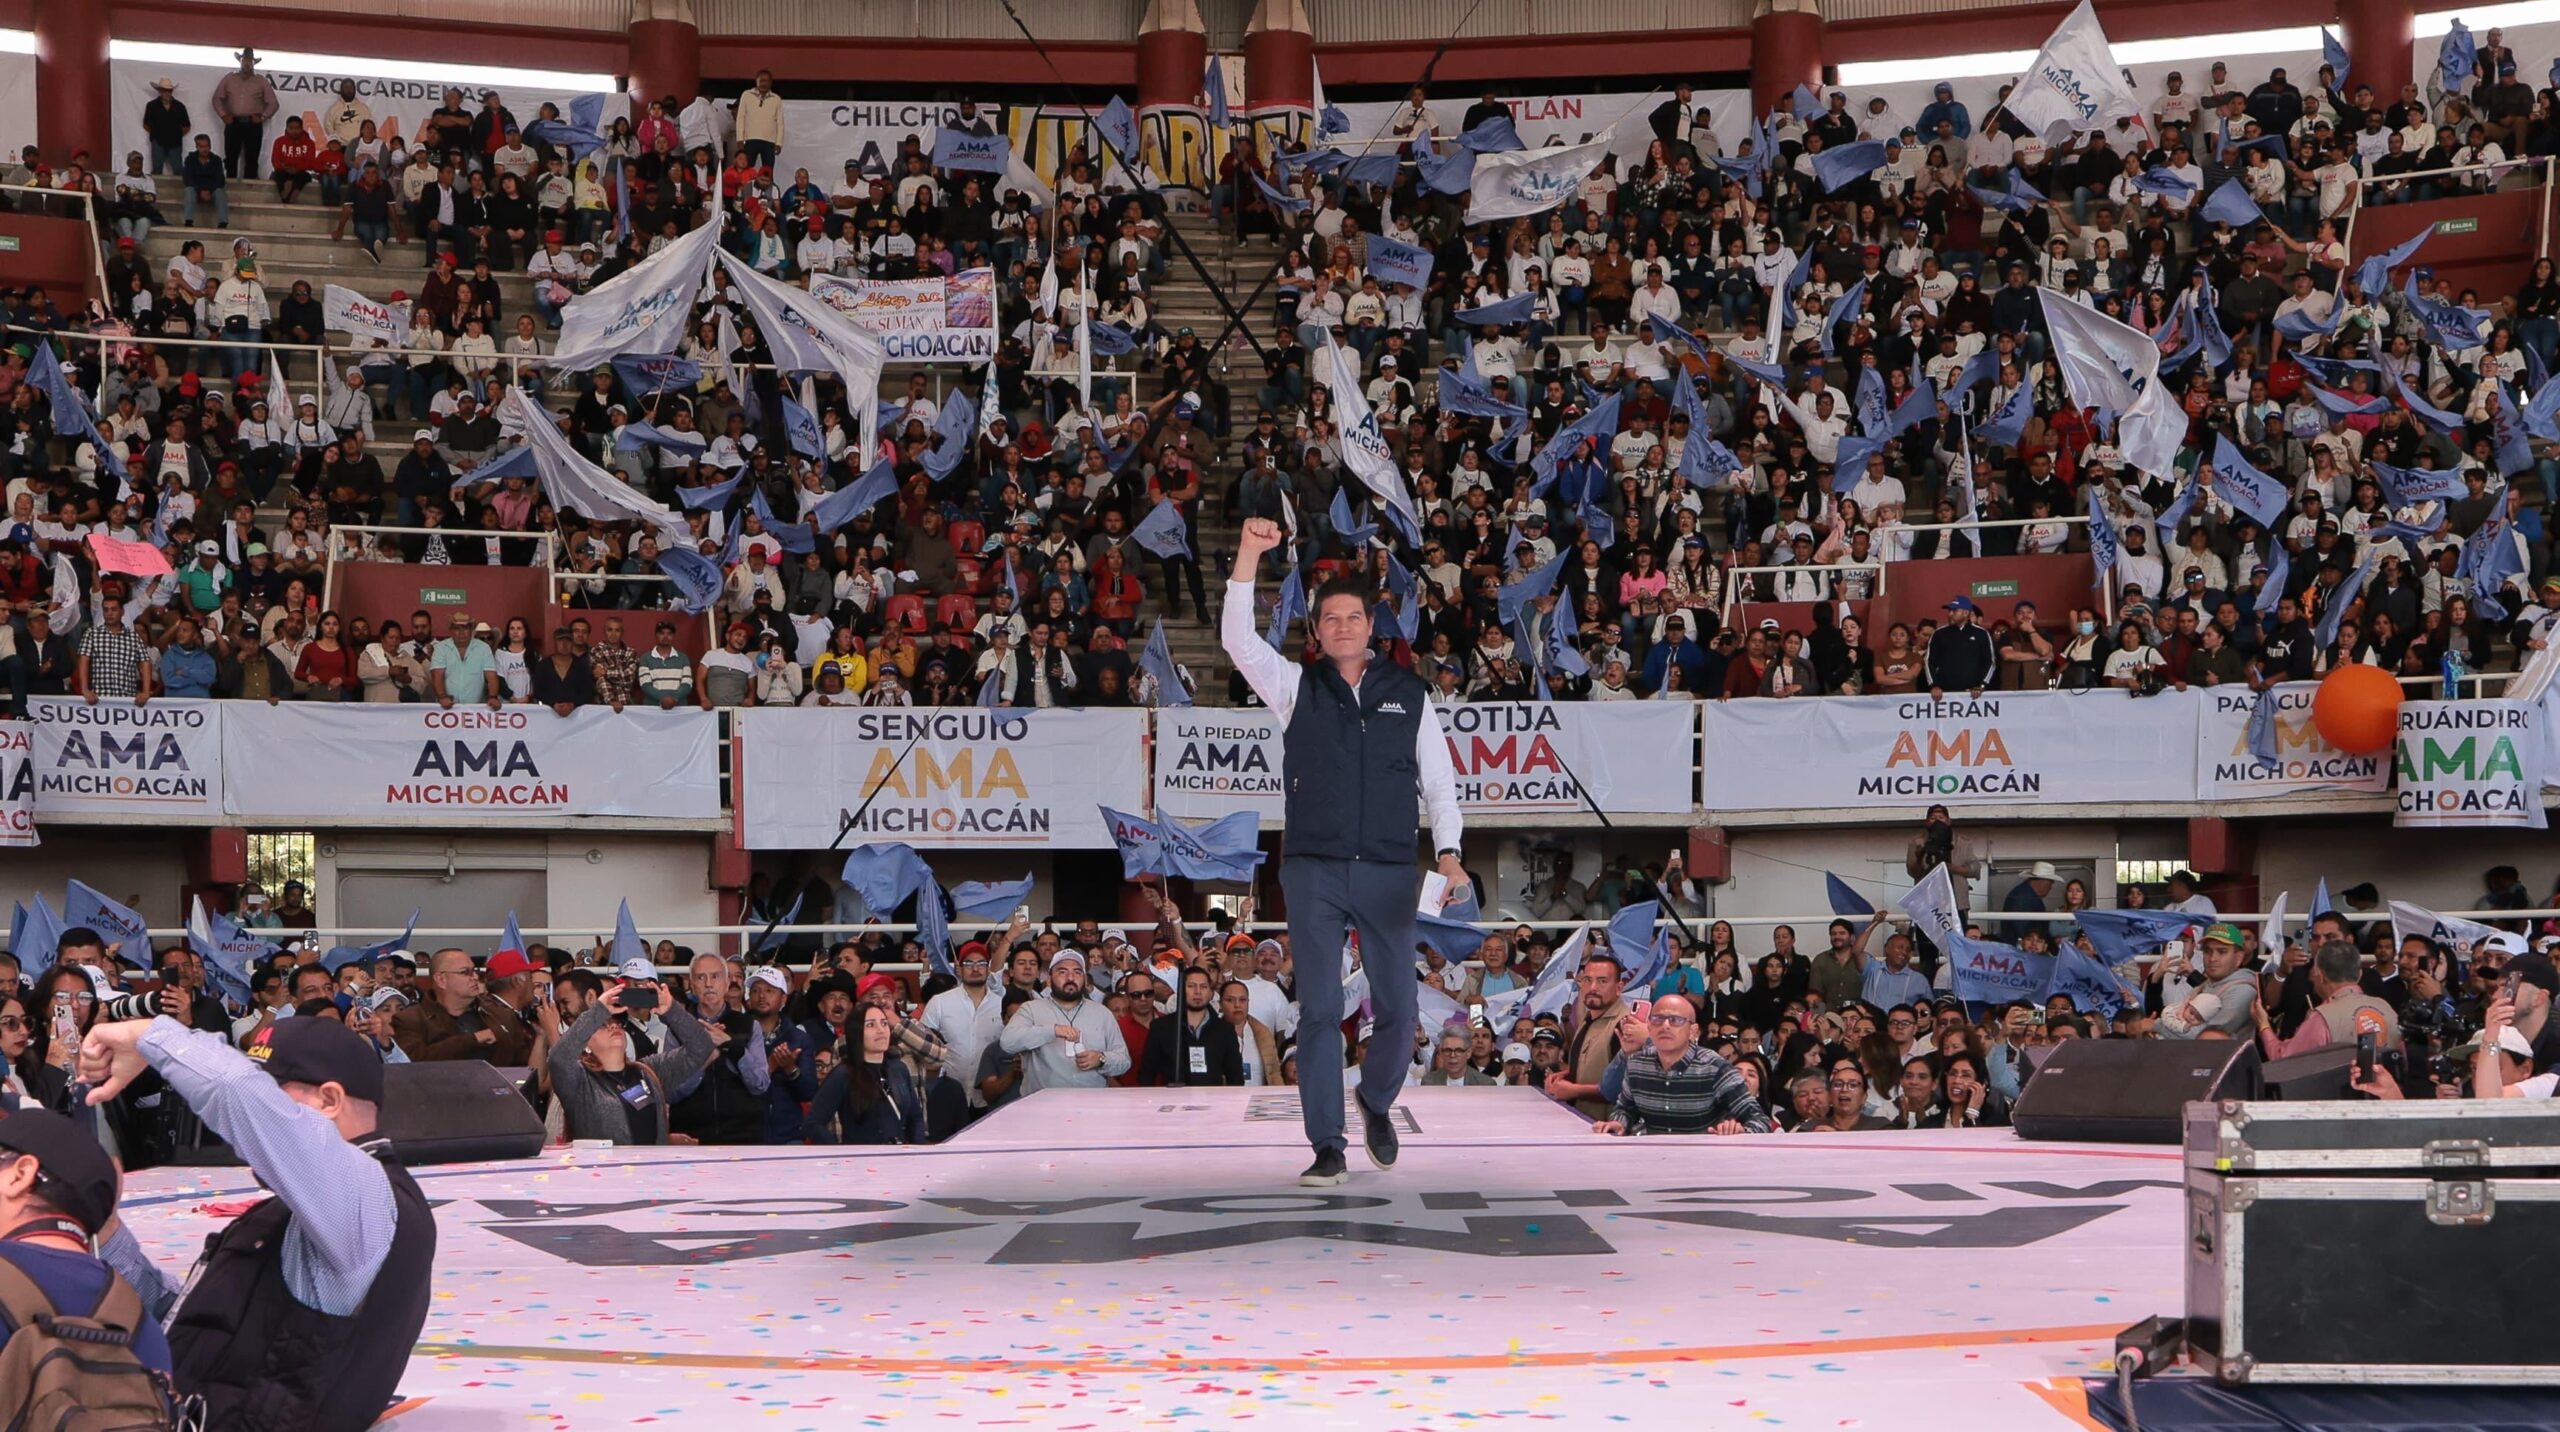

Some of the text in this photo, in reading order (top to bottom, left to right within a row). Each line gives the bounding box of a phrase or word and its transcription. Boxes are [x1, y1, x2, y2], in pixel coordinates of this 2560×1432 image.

[267, 71, 342, 94] ÁZARO
[2060, 67, 2100, 122] AMA
[832, 105, 959, 127] CHILCHO
[1508, 96, 1582, 120] TLÁN
[956, 141, 990, 152] AMA
[1379, 247, 1415, 265] AMA
[350, 301, 389, 321] AMA
[2424, 311, 2466, 327] AMA
[163, 453, 185, 461] AMA
[2222, 464, 2260, 496] AMA
[690, 562, 717, 595] AM
[1847, 571, 1867, 579] AMA
[2119, 661, 2136, 669] AM
[40, 704, 205, 728] SUSUPUATO
[424, 711, 528, 730] COENEO
[857, 714, 1028, 742] SENGUIO
[1434, 705, 1562, 733] COTIJA
[1177, 725, 1272, 741] LA PIEDAD
[56, 729, 191, 771] AMA
[412, 739, 541, 778] AMA
[1176, 742, 1271, 774] AMA
[1446, 734, 1562, 776] AMA
[1886, 729, 2013, 768] AMA
[2398, 736, 2524, 783] AMA
[858, 747, 1029, 799] AMA
[2215, 753, 2377, 782] MICHOACÁN
[41, 773, 207, 797] MICHOACÁN
[387, 780, 569, 804] MICHOACÁN
[1164, 773, 1282, 792] MICHOACÁN
[1455, 776, 1578, 802] CHOACÁN
[1858, 769, 2040, 796] MICHOACÁN
[2398, 784, 2529, 812] CHOACÁ
[839, 802, 1049, 832] MICHOACÁN
[1115, 823, 1158, 841] AM
[1161, 843, 1210, 861] MICHO
[85, 914, 131, 938] MICHO
[1969, 952, 2026, 976] AMA
[481, 1204, 2130, 1267] AMA
